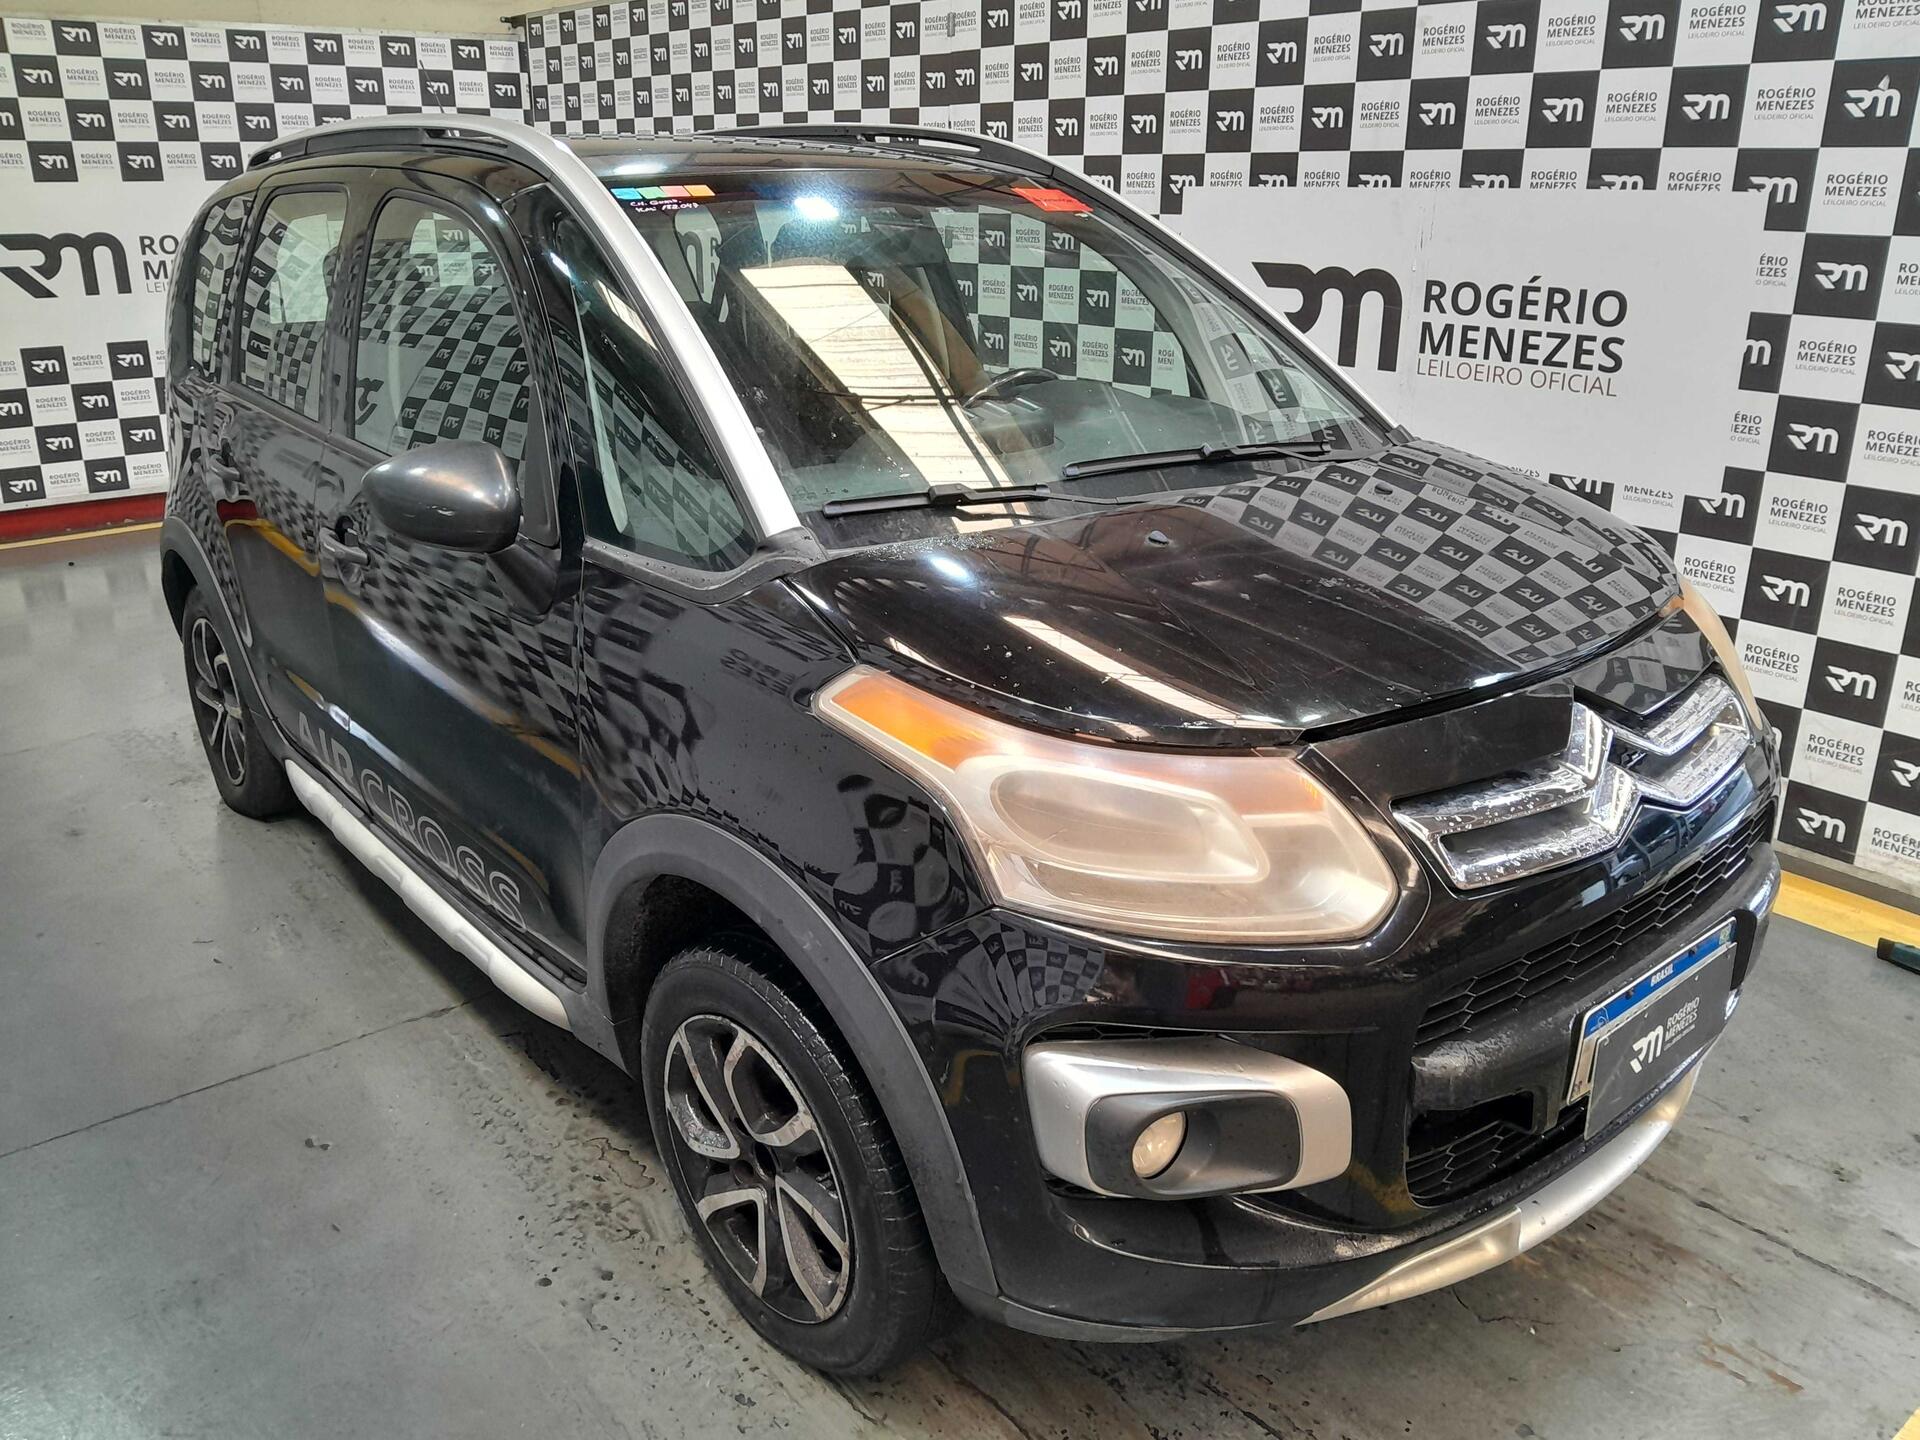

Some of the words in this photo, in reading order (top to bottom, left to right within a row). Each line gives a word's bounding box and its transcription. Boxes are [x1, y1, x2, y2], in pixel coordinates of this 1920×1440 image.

[1020, 1, 1045, 13] ROGÉRIO
[1690, 4, 1747, 18] ROGÉRIO
[1856, 5, 1920, 19] MENEZES
[1019, 10, 1045, 19] MENEZES
[1548, 15, 1596, 27] ROGÉRIO
[1689, 16, 1746, 30] MENEZES
[1423, 24, 1466, 36] ROGÉRIO
[1547, 26, 1595, 38] MENEZES
[1314, 33, 1351, 45] ROGÉRIO
[1422, 35, 1465, 47] MENEZES
[1217, 41, 1251, 53] ROGÉRIO
[1313, 43, 1351, 55] MENEZES
[1054, 55, 1081, 66] ROGÉRIO
[1131, 49, 1161, 61] ROGÉRIO
[1217, 50, 1251, 62] MENEZES
[1054, 64, 1081, 74] MENEZES
[1130, 58, 1161, 69] MENEZES
[1607, 89, 1657, 103] ROGÉRIO
[1757, 86, 1816, 99] ROGÉRIO
[1361, 100, 1400, 112] ROGÉRIO
[1475, 95, 1520, 108] ROGÉRIO
[1605, 101, 1657, 114] MENEZES
[1755, 98, 1815, 111] MENEZES
[1170, 108, 1201, 119] ROGÉRIO
[1260, 104, 1294, 115] ROGÉRIO
[1360, 110, 1399, 121] MENEZES
[1474, 106, 1520, 117] MENEZES
[1090, 112, 1118, 123] ROGÉRIO
[1169, 117, 1201, 128] MENEZES
[1259, 114, 1294, 125] MENEZES
[1089, 121, 1118, 131] MENEZES
[1127, 171, 1156, 181] ROGÉRIO
[1410, 169, 1451, 181] ROGÉRIO
[1530, 169, 1577, 182] ROGÉRIO
[1668, 170, 1722, 183] ROGÉRIO
[1826, 172, 1889, 186] ROGÉRIO
[1126, 180, 1155, 189] MENEZES
[1409, 179, 1450, 188] MENEZES
[1530, 179, 1577, 189] MENEZES
[1667, 182, 1721, 191] MENEZES
[1824, 184, 1887, 198] MENEZES
[1759, 253, 1788, 267] ÉRIO
[1423, 276, 1628, 328] ROGÉRIO
[1419, 321, 1626, 373] MENEZES
[1799, 340, 1857, 355] ROGÉRIO
[1797, 351, 1856, 366] MENEZES
[1416, 357, 1522, 386] LEILOEIRO
[1530, 370, 1617, 397] OFICIAL
[1734, 411, 1762, 425] ÉRIO
[1868, 430, 1920, 446] ROGÉRI
[1866, 441, 1920, 457] MENEZE
[1624, 484, 1673, 500] MENEZES
[1772, 496, 1828, 514] ROGÉRIO
[1770, 507, 1827, 525] MENEZES
[1684, 557, 1736, 574] ROGÉRIO
[1682, 567, 1735, 584] MENEZES
[1837, 587, 1896, 606] ROGÉRIO
[1835, 597, 1895, 617] MENEZES
[1745, 643, 1800, 663] ROGÉRIO
[1744, 653, 1799, 674] MENEZES
[1808, 733, 1865, 755] ROGÉRIO
[1806, 744, 1864, 766] MENEZES
[1873, 827, 1920, 849] ROGÉRI
[1871, 837, 1920, 860] MENEZE
[1650, 963, 1674, 987] BRASIL
[1666, 997, 1699, 1029] ROGÉRIO
[1665, 1009, 1697, 1041] MENEZES
